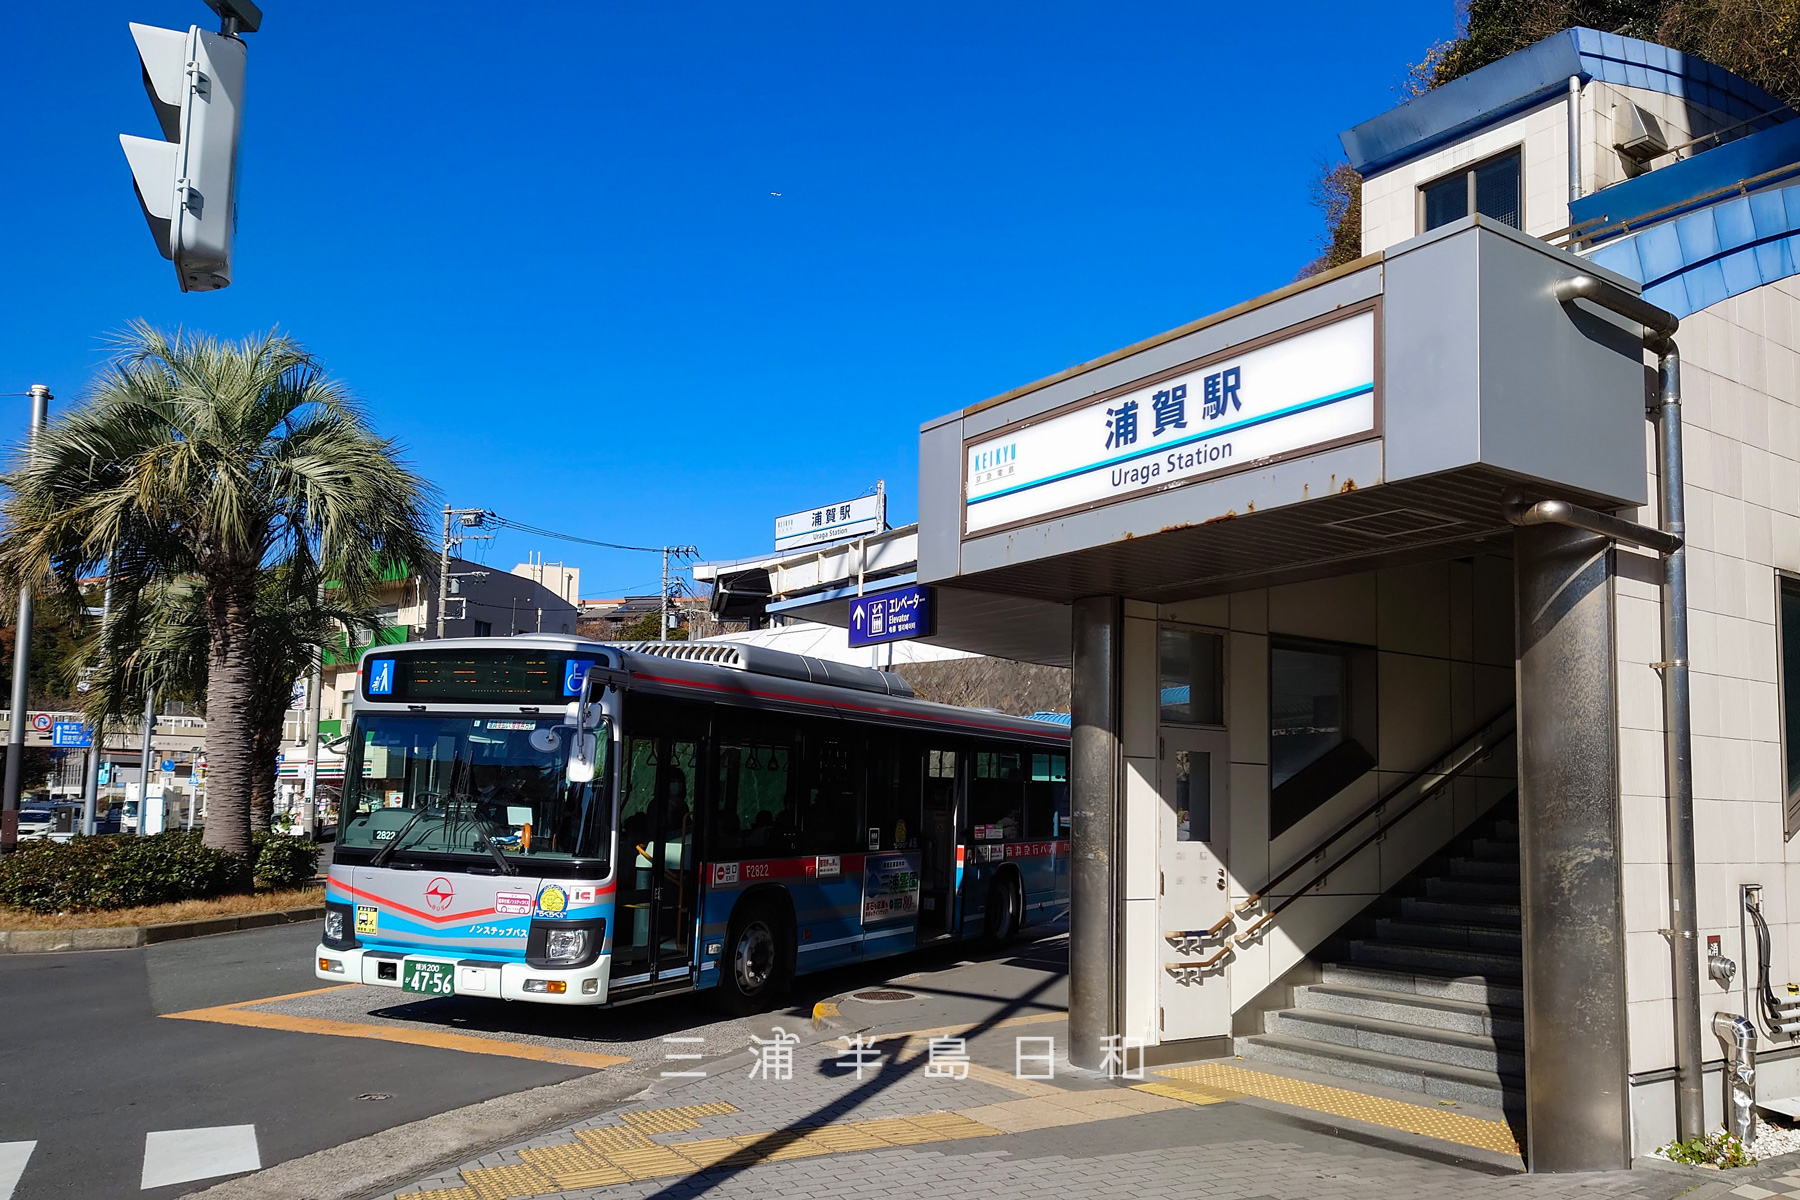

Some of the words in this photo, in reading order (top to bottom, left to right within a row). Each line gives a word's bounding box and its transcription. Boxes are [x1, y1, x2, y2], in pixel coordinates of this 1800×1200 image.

[1105, 366, 1242, 450] 浦賀駅
[975, 443, 1016, 472] KEIKYU
[1111, 460, 1160, 488] Uraga
[1167, 441, 1232, 474] Station
[811, 504, 851, 527] 浦賀駅
[812, 531, 829, 541] Uraga
[829, 527, 848, 536] Station
[889, 593, 926, 613] エレベーター
[888, 613, 910, 624] Elevator
[376, 830, 396, 840] 2822
[746, 864, 770, 878] F2822
[431, 904, 446, 912] BUS
[468, 924, 528, 938] ノンステップバス
